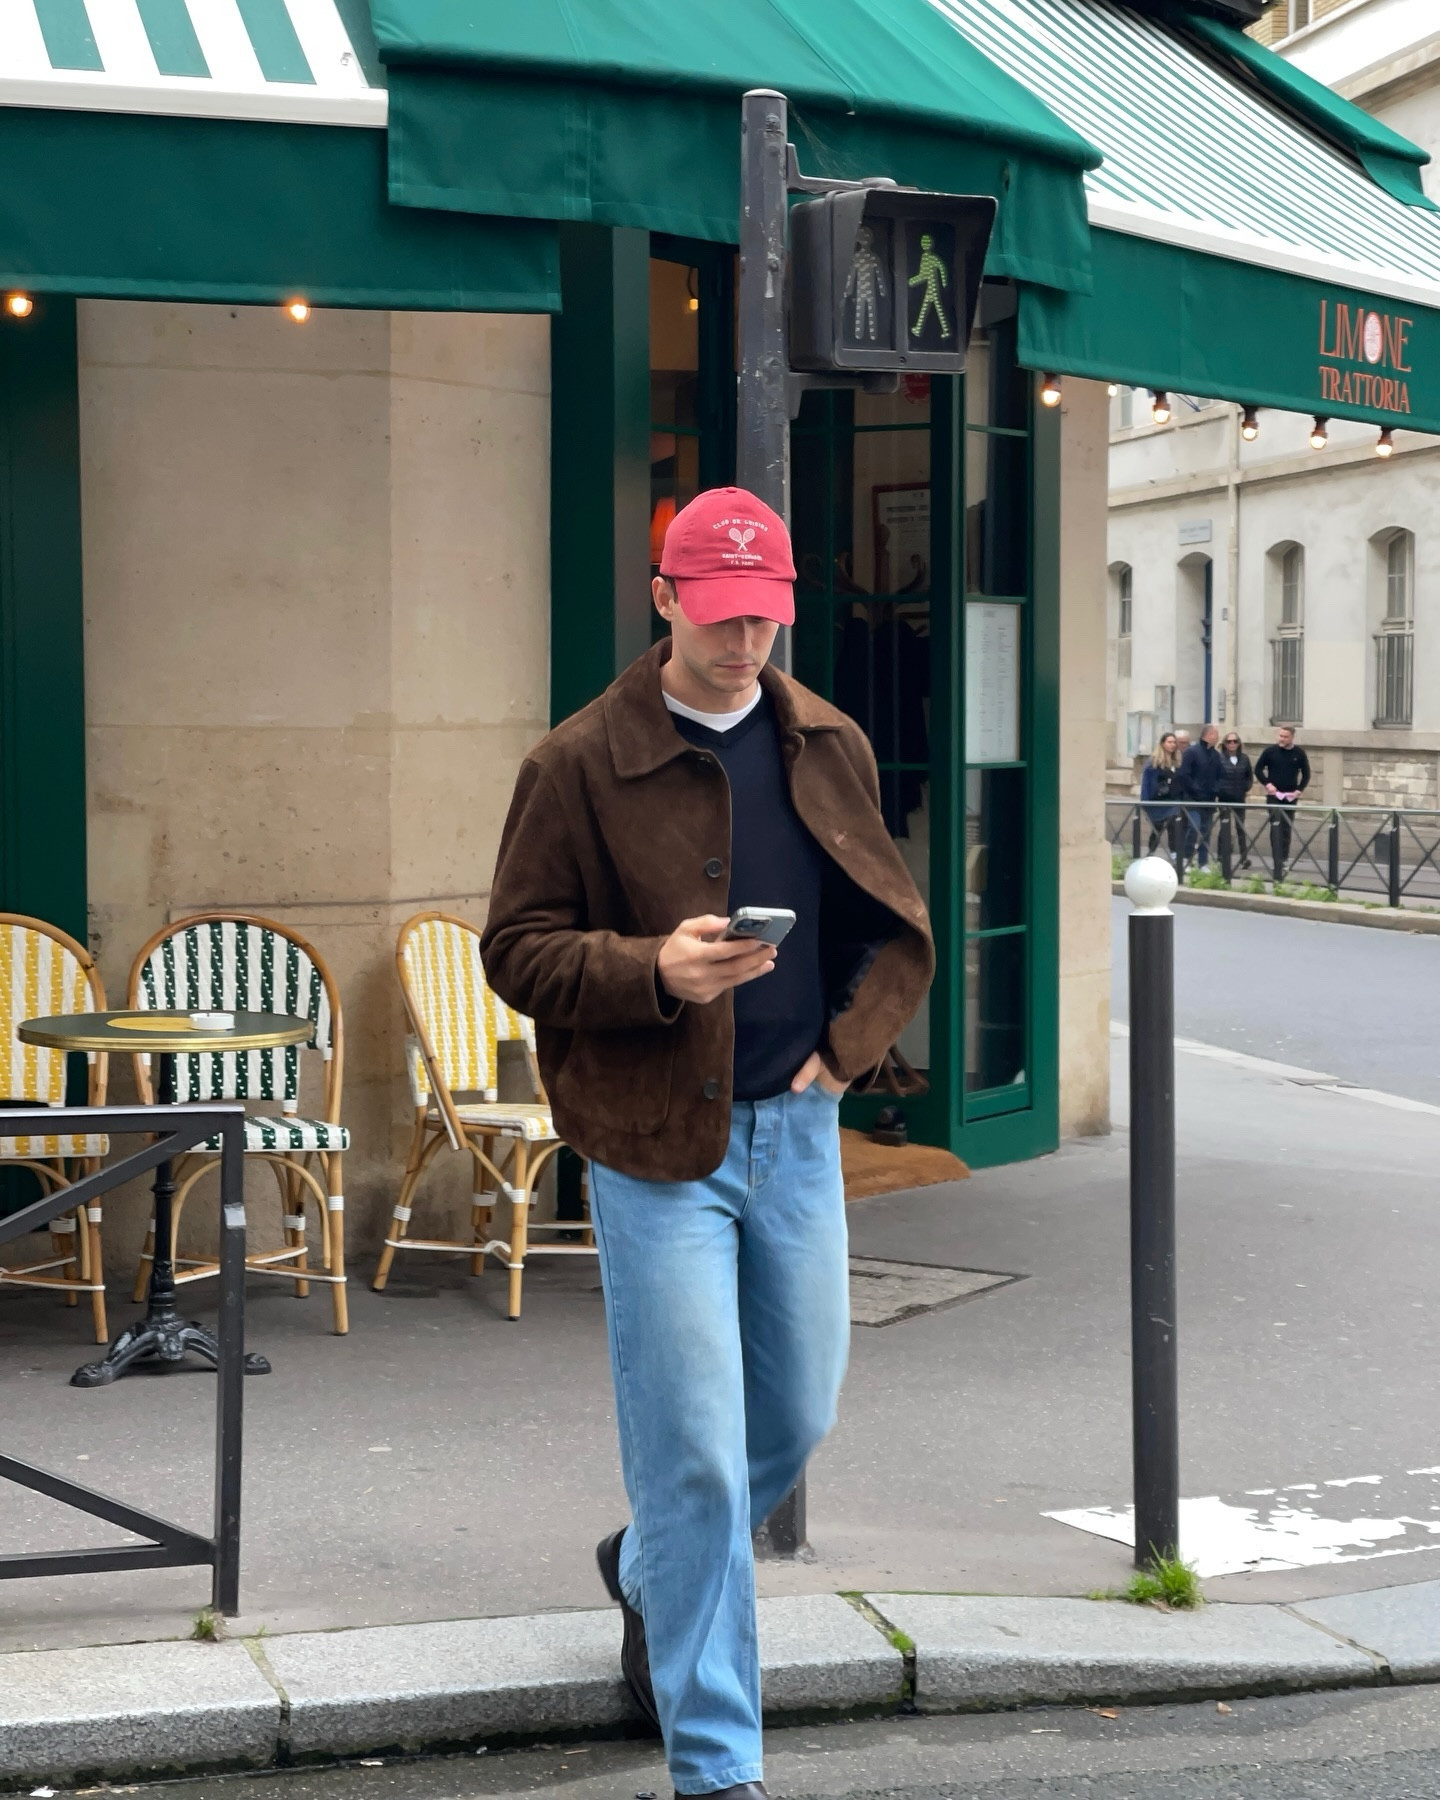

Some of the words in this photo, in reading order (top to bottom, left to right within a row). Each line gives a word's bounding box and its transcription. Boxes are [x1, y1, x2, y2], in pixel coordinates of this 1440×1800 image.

[1319, 300, 1413, 372] LIMONE
[1318, 366, 1411, 413] TRATTORIA
[712, 519, 729, 529] CLUB
